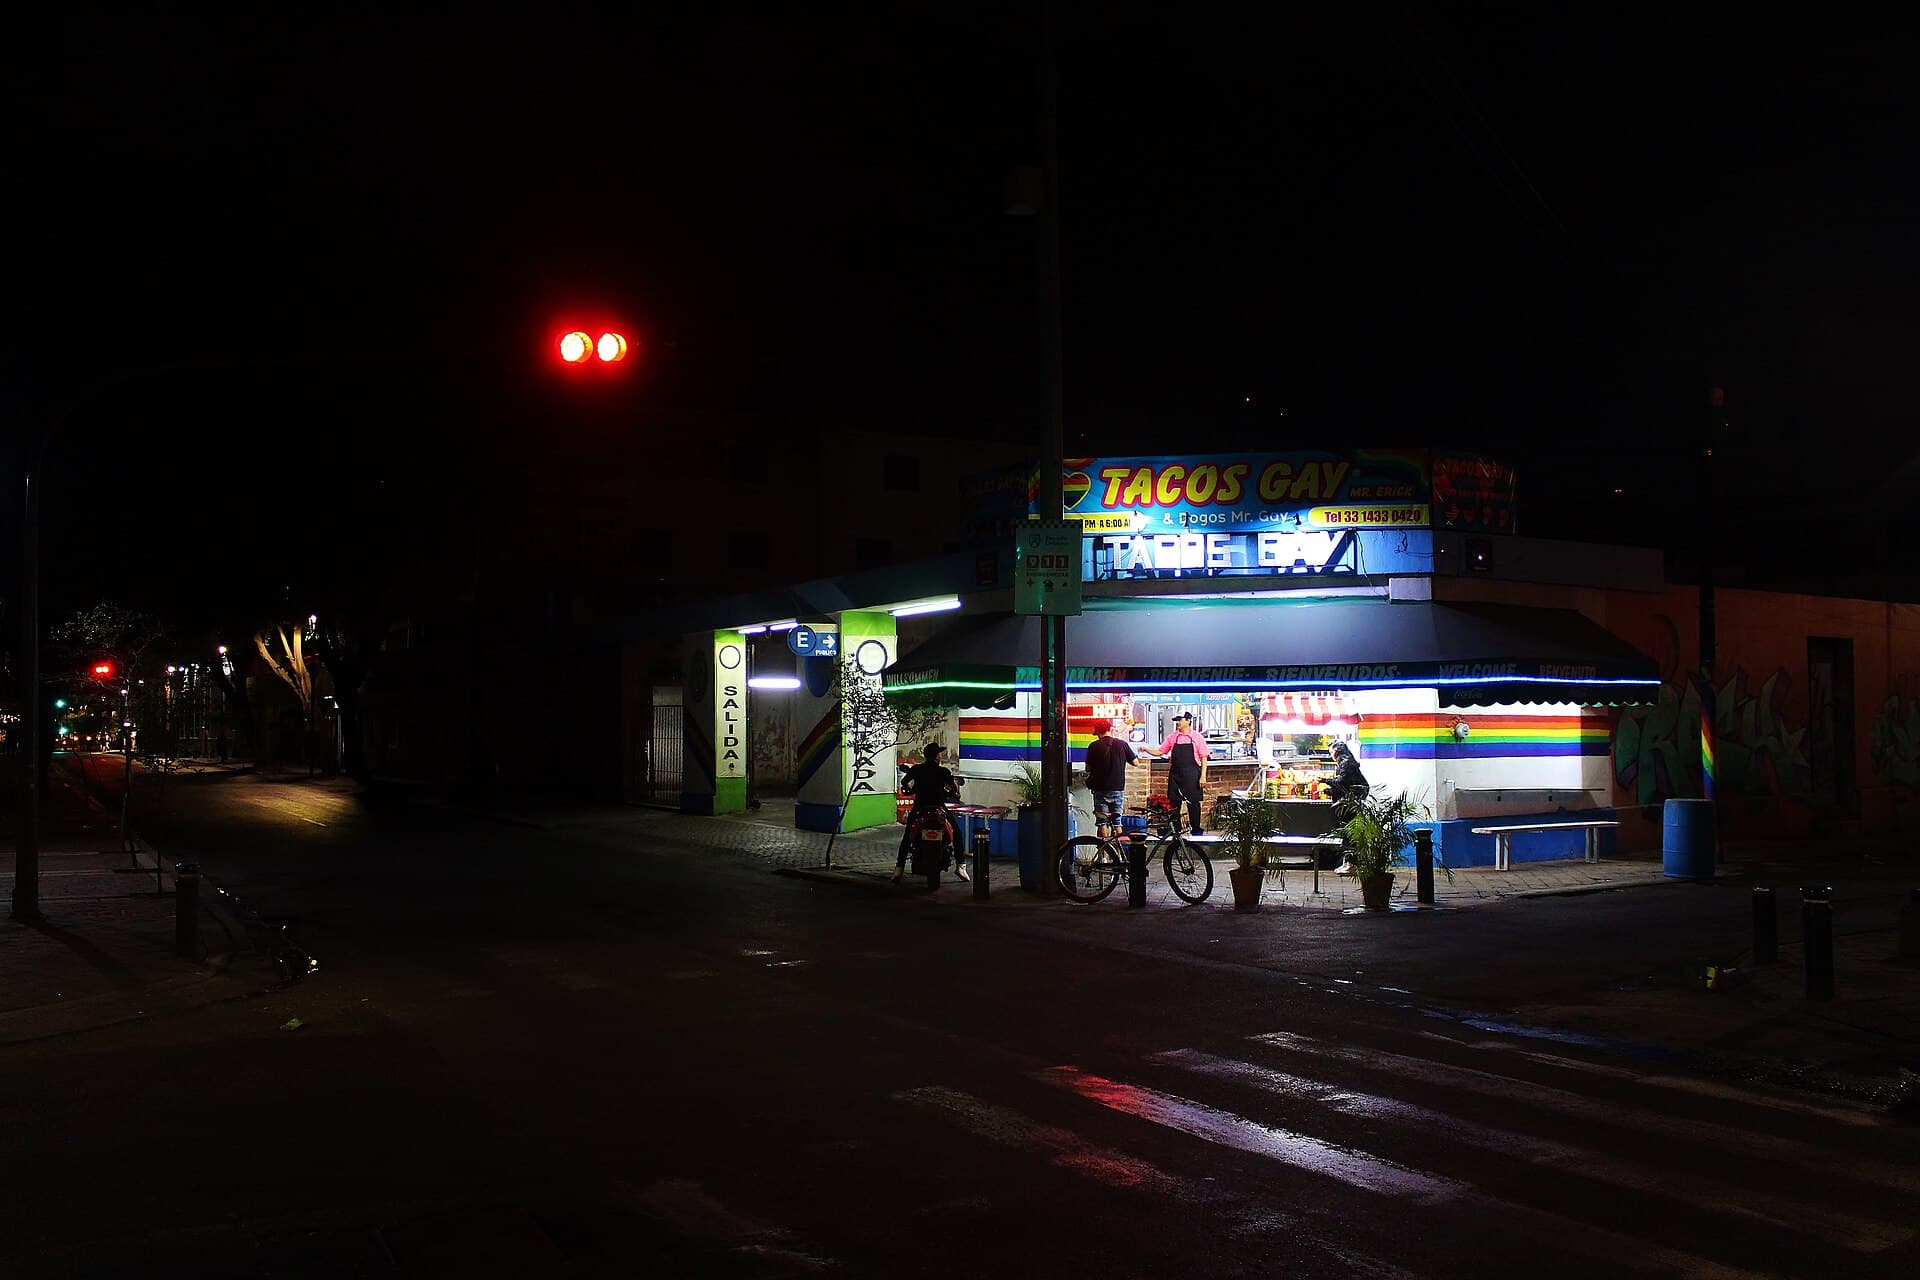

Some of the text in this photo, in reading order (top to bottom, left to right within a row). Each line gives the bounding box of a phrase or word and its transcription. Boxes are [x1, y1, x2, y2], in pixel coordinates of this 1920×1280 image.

[1102, 462, 1349, 506] TACOS GAY
[1376, 485, 1414, 497] ERICK
[1163, 512, 1174, 524] &
[1231, 510, 1254, 523] Mr.
[1259, 510, 1289, 525] Gay
[1324, 509, 1421, 523] Tel 33 1433 0420
[1084, 519, 1096, 529] PM
[1028, 556, 1067, 568] 911
[797, 631, 809, 648] E
[1265, 665, 1399, 681] BIENVENIDOS
[1439, 663, 1517, 679] WELCOME
[1093, 704, 1126, 718] HOT
[723, 686, 739, 760] SALIDA
